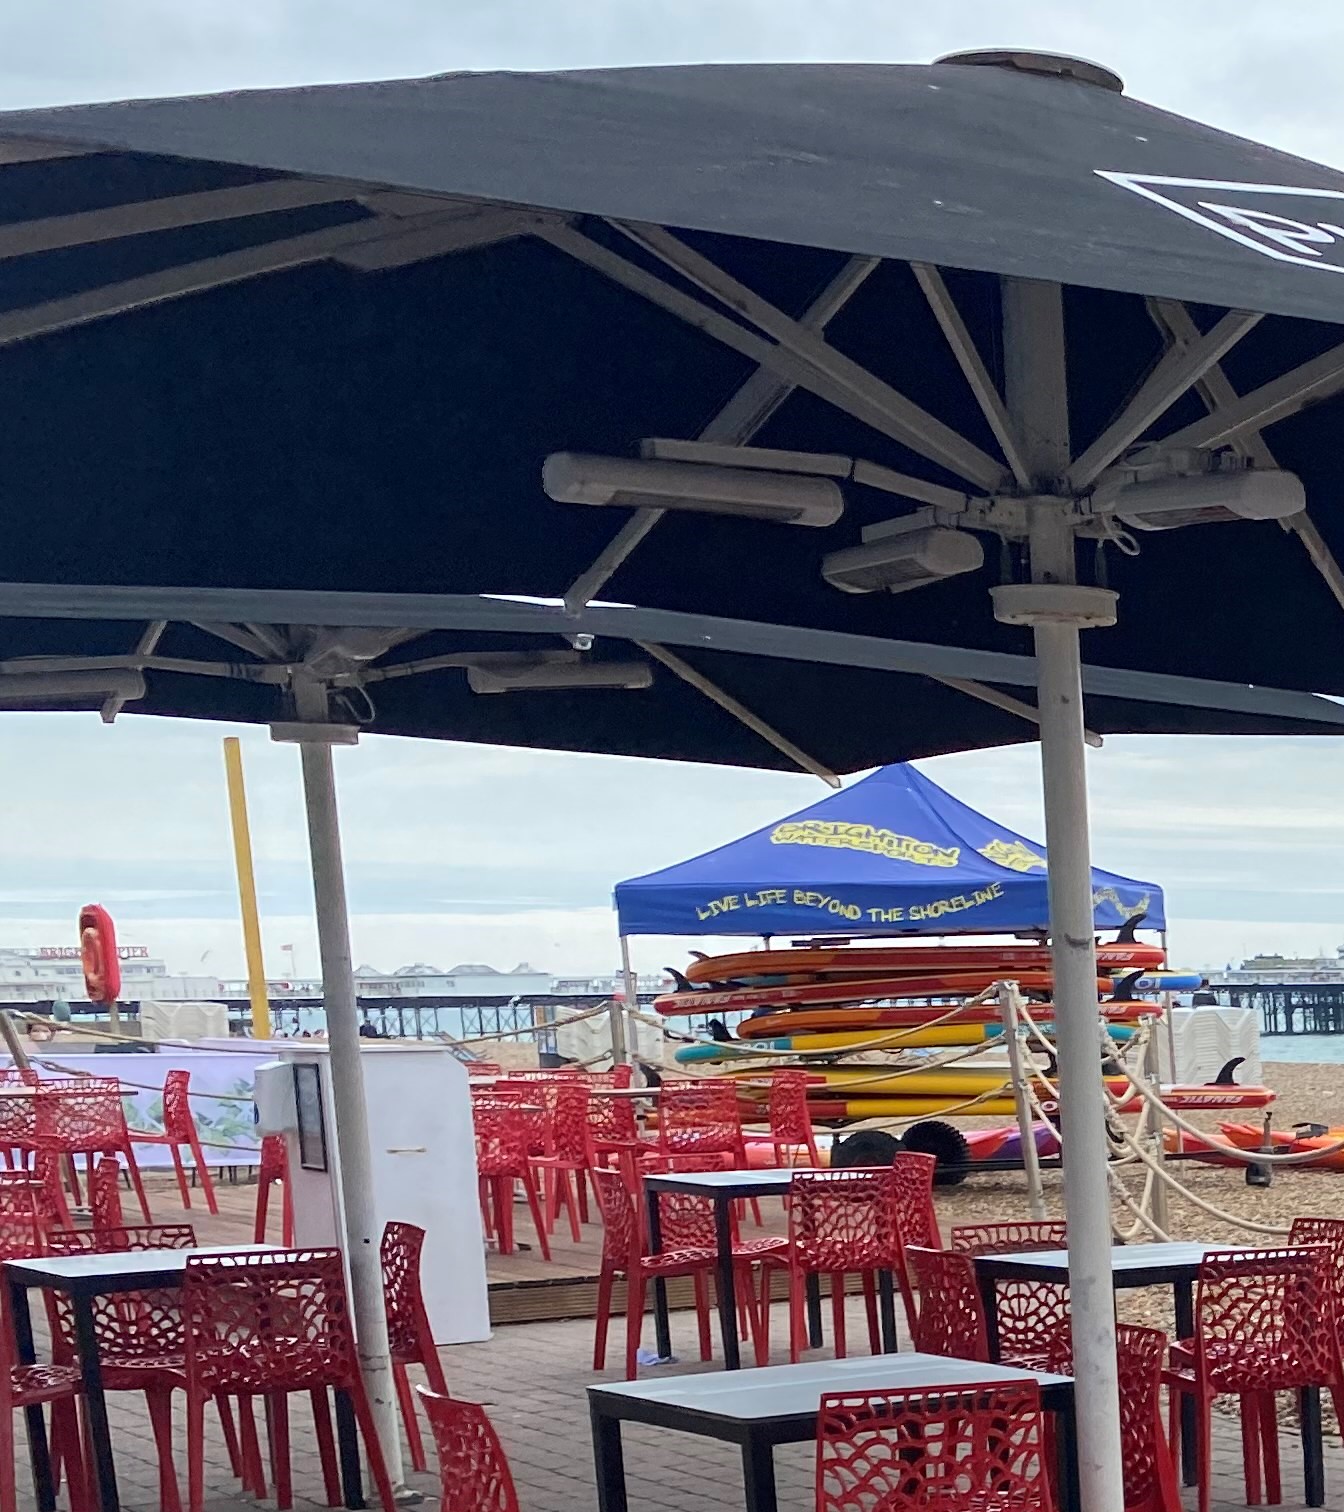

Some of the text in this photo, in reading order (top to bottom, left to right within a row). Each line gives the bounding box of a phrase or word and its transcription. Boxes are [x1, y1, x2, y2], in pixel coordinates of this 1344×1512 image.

[696, 882, 1005, 922] LIVE LIFE BEYOND THE SHORELINE
